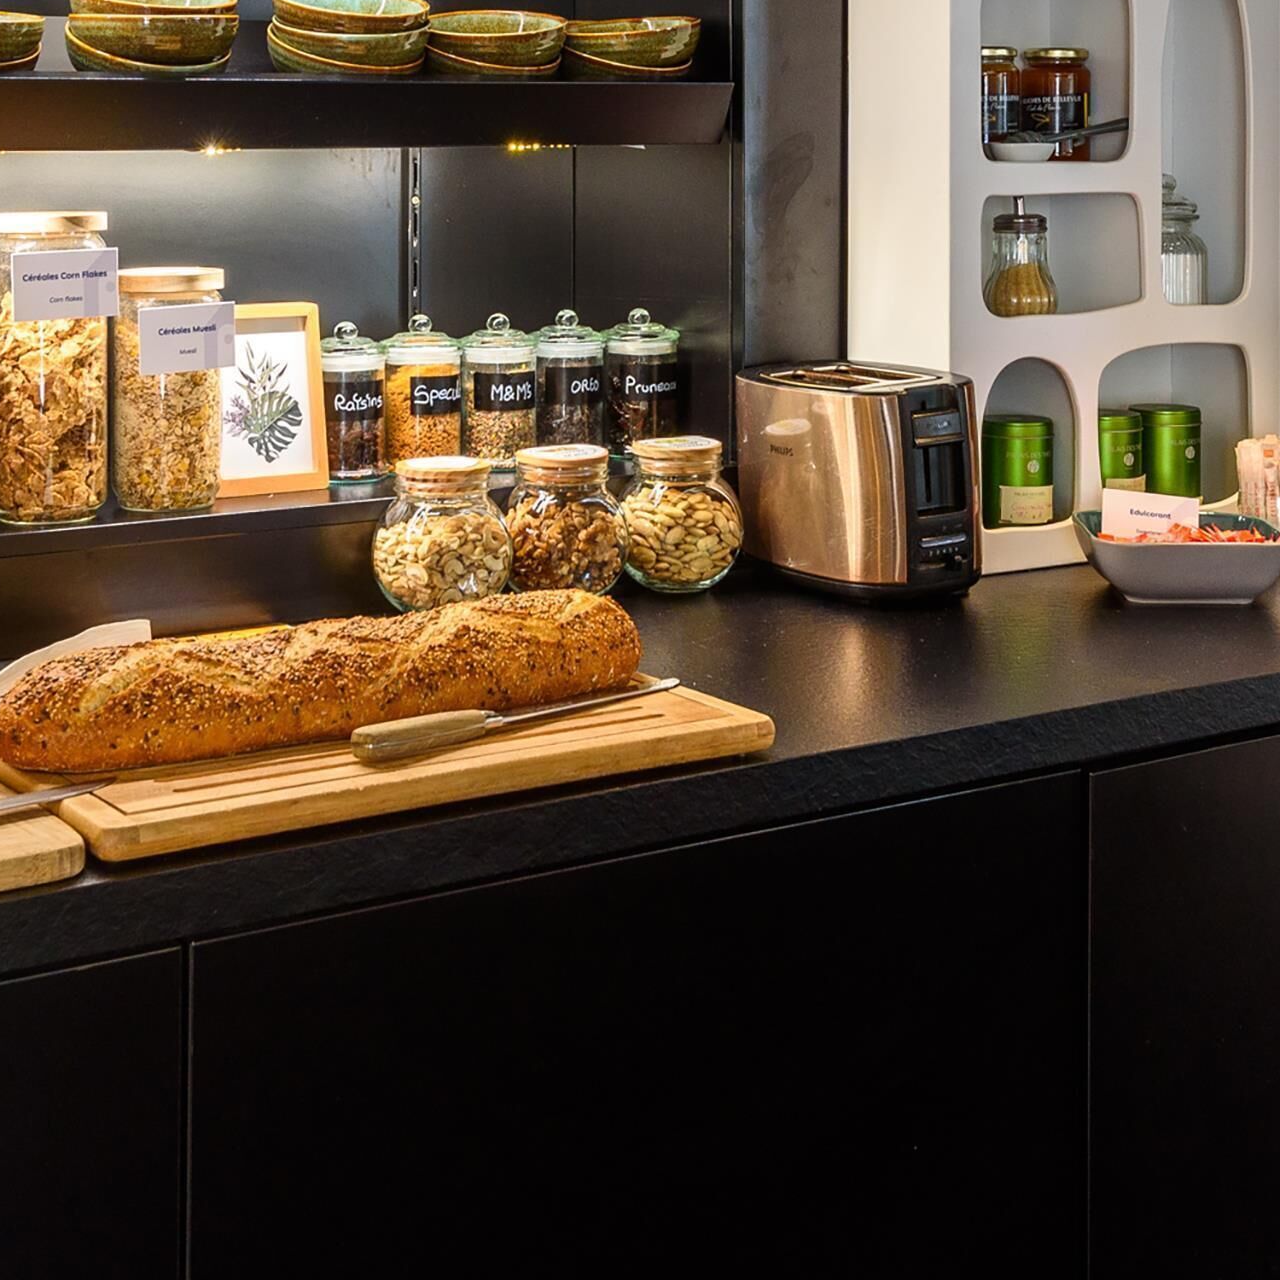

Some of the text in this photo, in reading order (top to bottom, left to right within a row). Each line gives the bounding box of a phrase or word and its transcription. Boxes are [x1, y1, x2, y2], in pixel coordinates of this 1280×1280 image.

[22, 270, 108, 282] Céréales Corn Flakes
[49, 296, 64, 304] Corn
[158, 324, 217, 336] Céréales Muesli
[770, 444, 794, 457] PHILIPS
[1129, 508, 1172, 520] Edulcorant
